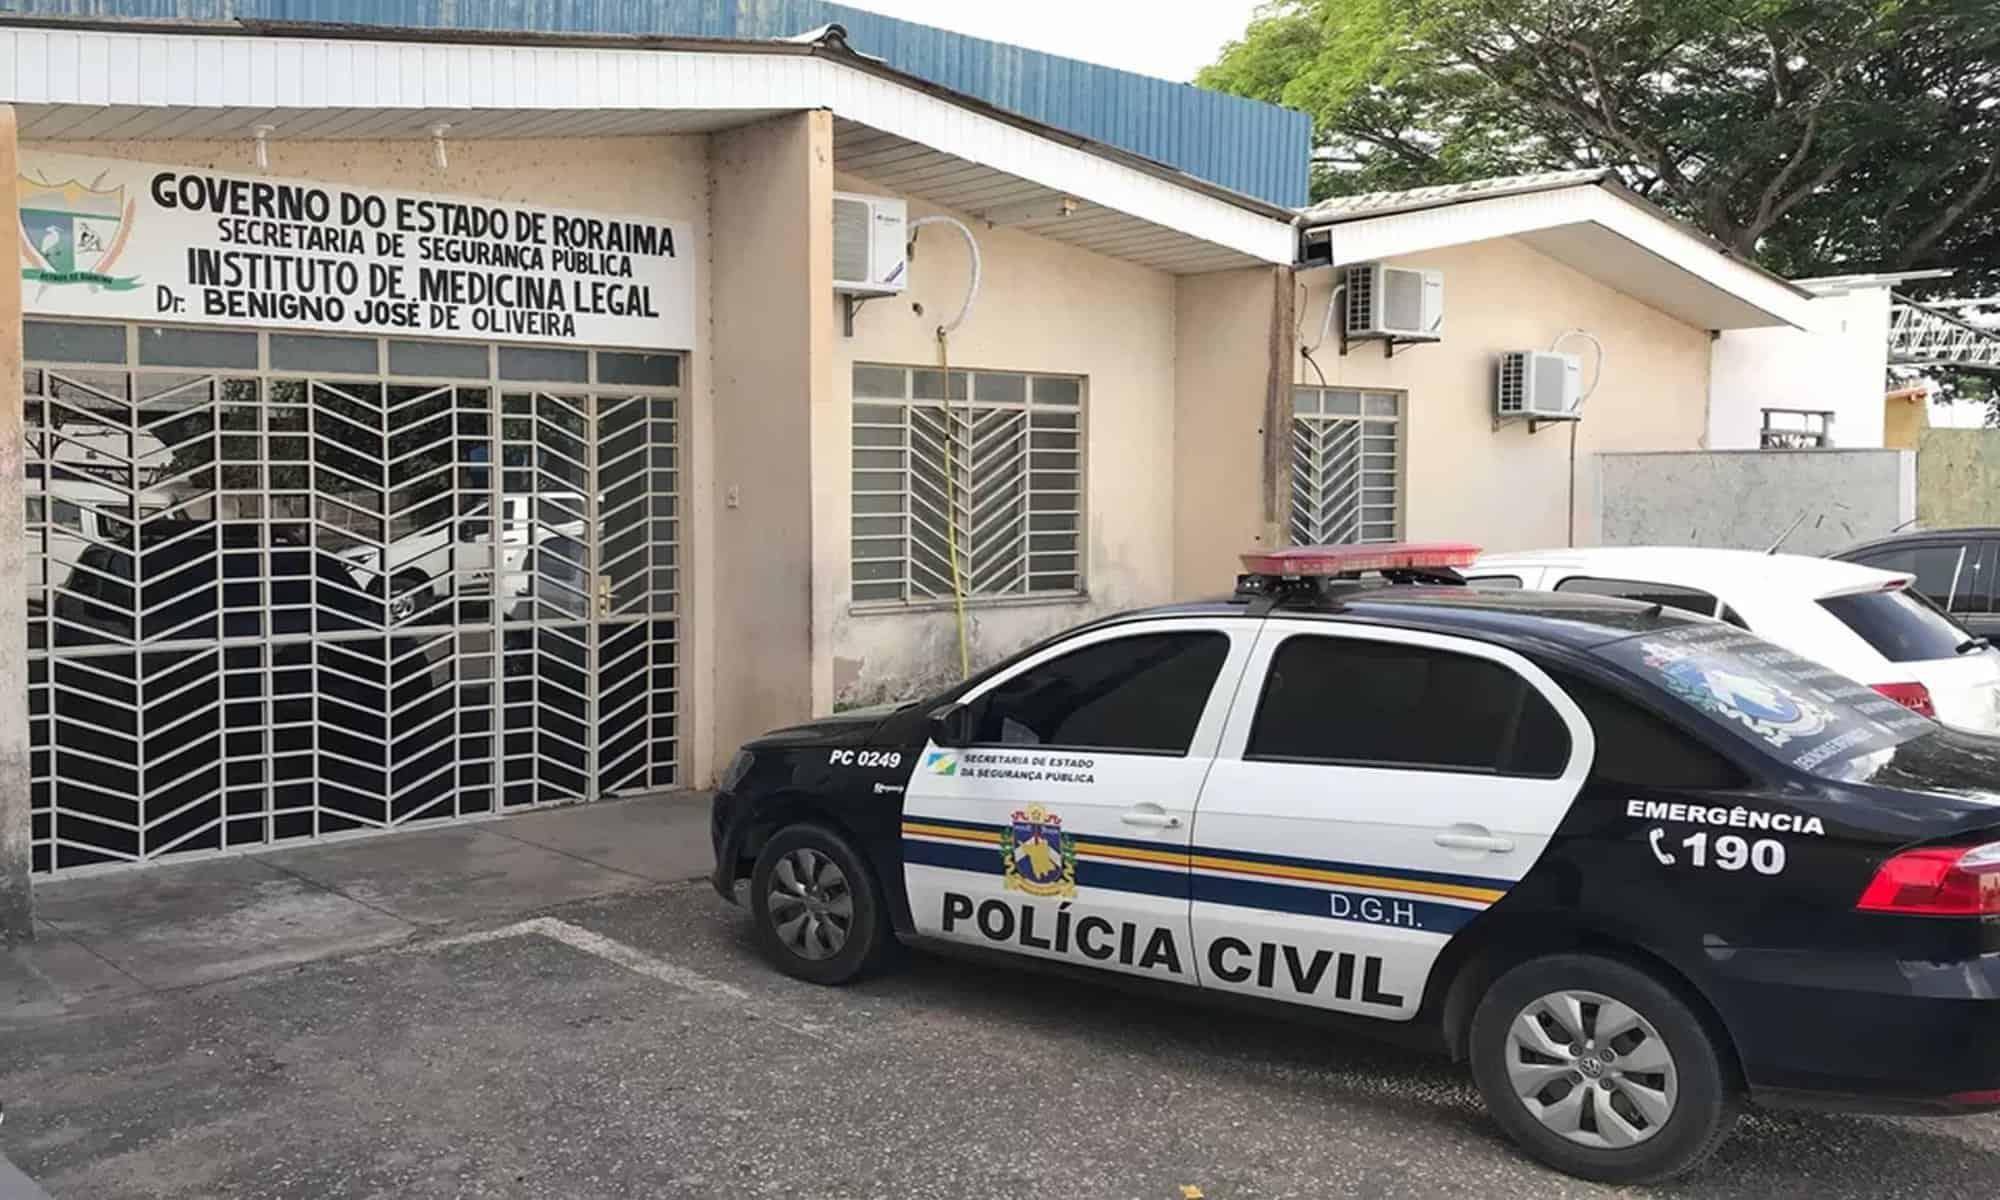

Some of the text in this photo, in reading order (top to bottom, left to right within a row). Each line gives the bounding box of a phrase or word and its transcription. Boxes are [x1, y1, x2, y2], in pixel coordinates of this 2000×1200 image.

[151, 172, 676, 258] GOVERNO DO ESTADO DE RORAIMA
[218, 217, 633, 278] SECRETARIA DE SEGURANÇA PÚBLICA
[188, 248, 659, 318] INSTITUTO DE MEDICINA LEGAL
[157, 285, 576, 337] Dr. BENIGNO JOSÉ DE OLIVEIRA
[829, 750, 901, 768] PC 0249
[960, 768, 974, 776] DA
[977, 769, 1042, 781] SEGURANÇA
[964, 754, 1094, 768] SECRETARIA DE ESTADO
[1627, 800, 1825, 835] EMERGÊNCIA
[1683, 832, 1786, 875] 190
[1331, 893, 1422, 927] D.G.H.
[942, 892, 1404, 1007] POLÍCIA CIVIL
